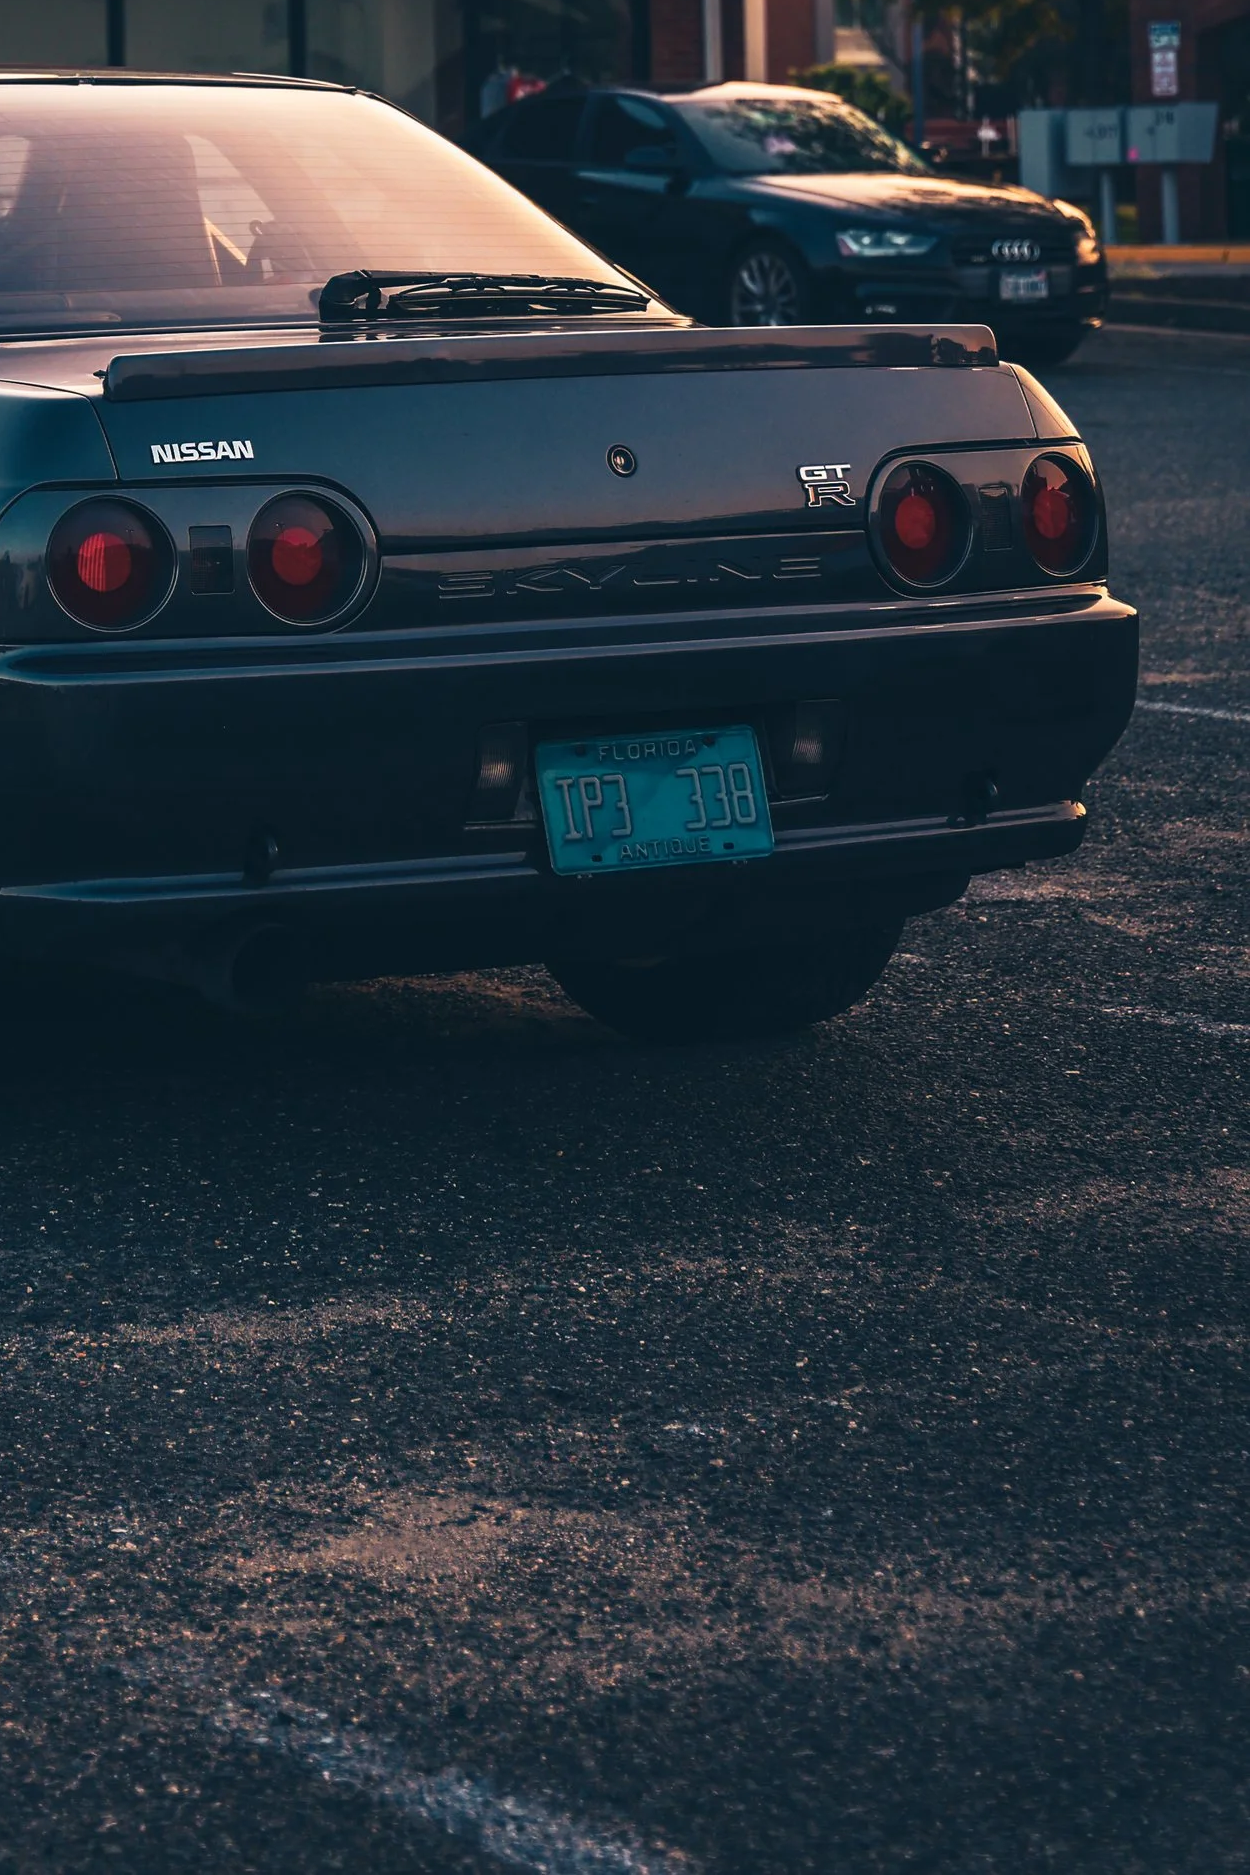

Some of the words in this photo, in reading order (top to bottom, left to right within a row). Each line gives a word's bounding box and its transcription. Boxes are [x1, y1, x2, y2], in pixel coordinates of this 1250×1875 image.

[150, 440, 254, 463] NISSAN
[437, 556, 822, 600] SKYLINE
[598, 738, 697, 762] FLORIDA
[676, 762, 757, 830] 338
[619, 836, 712, 860] ANTIQUE
